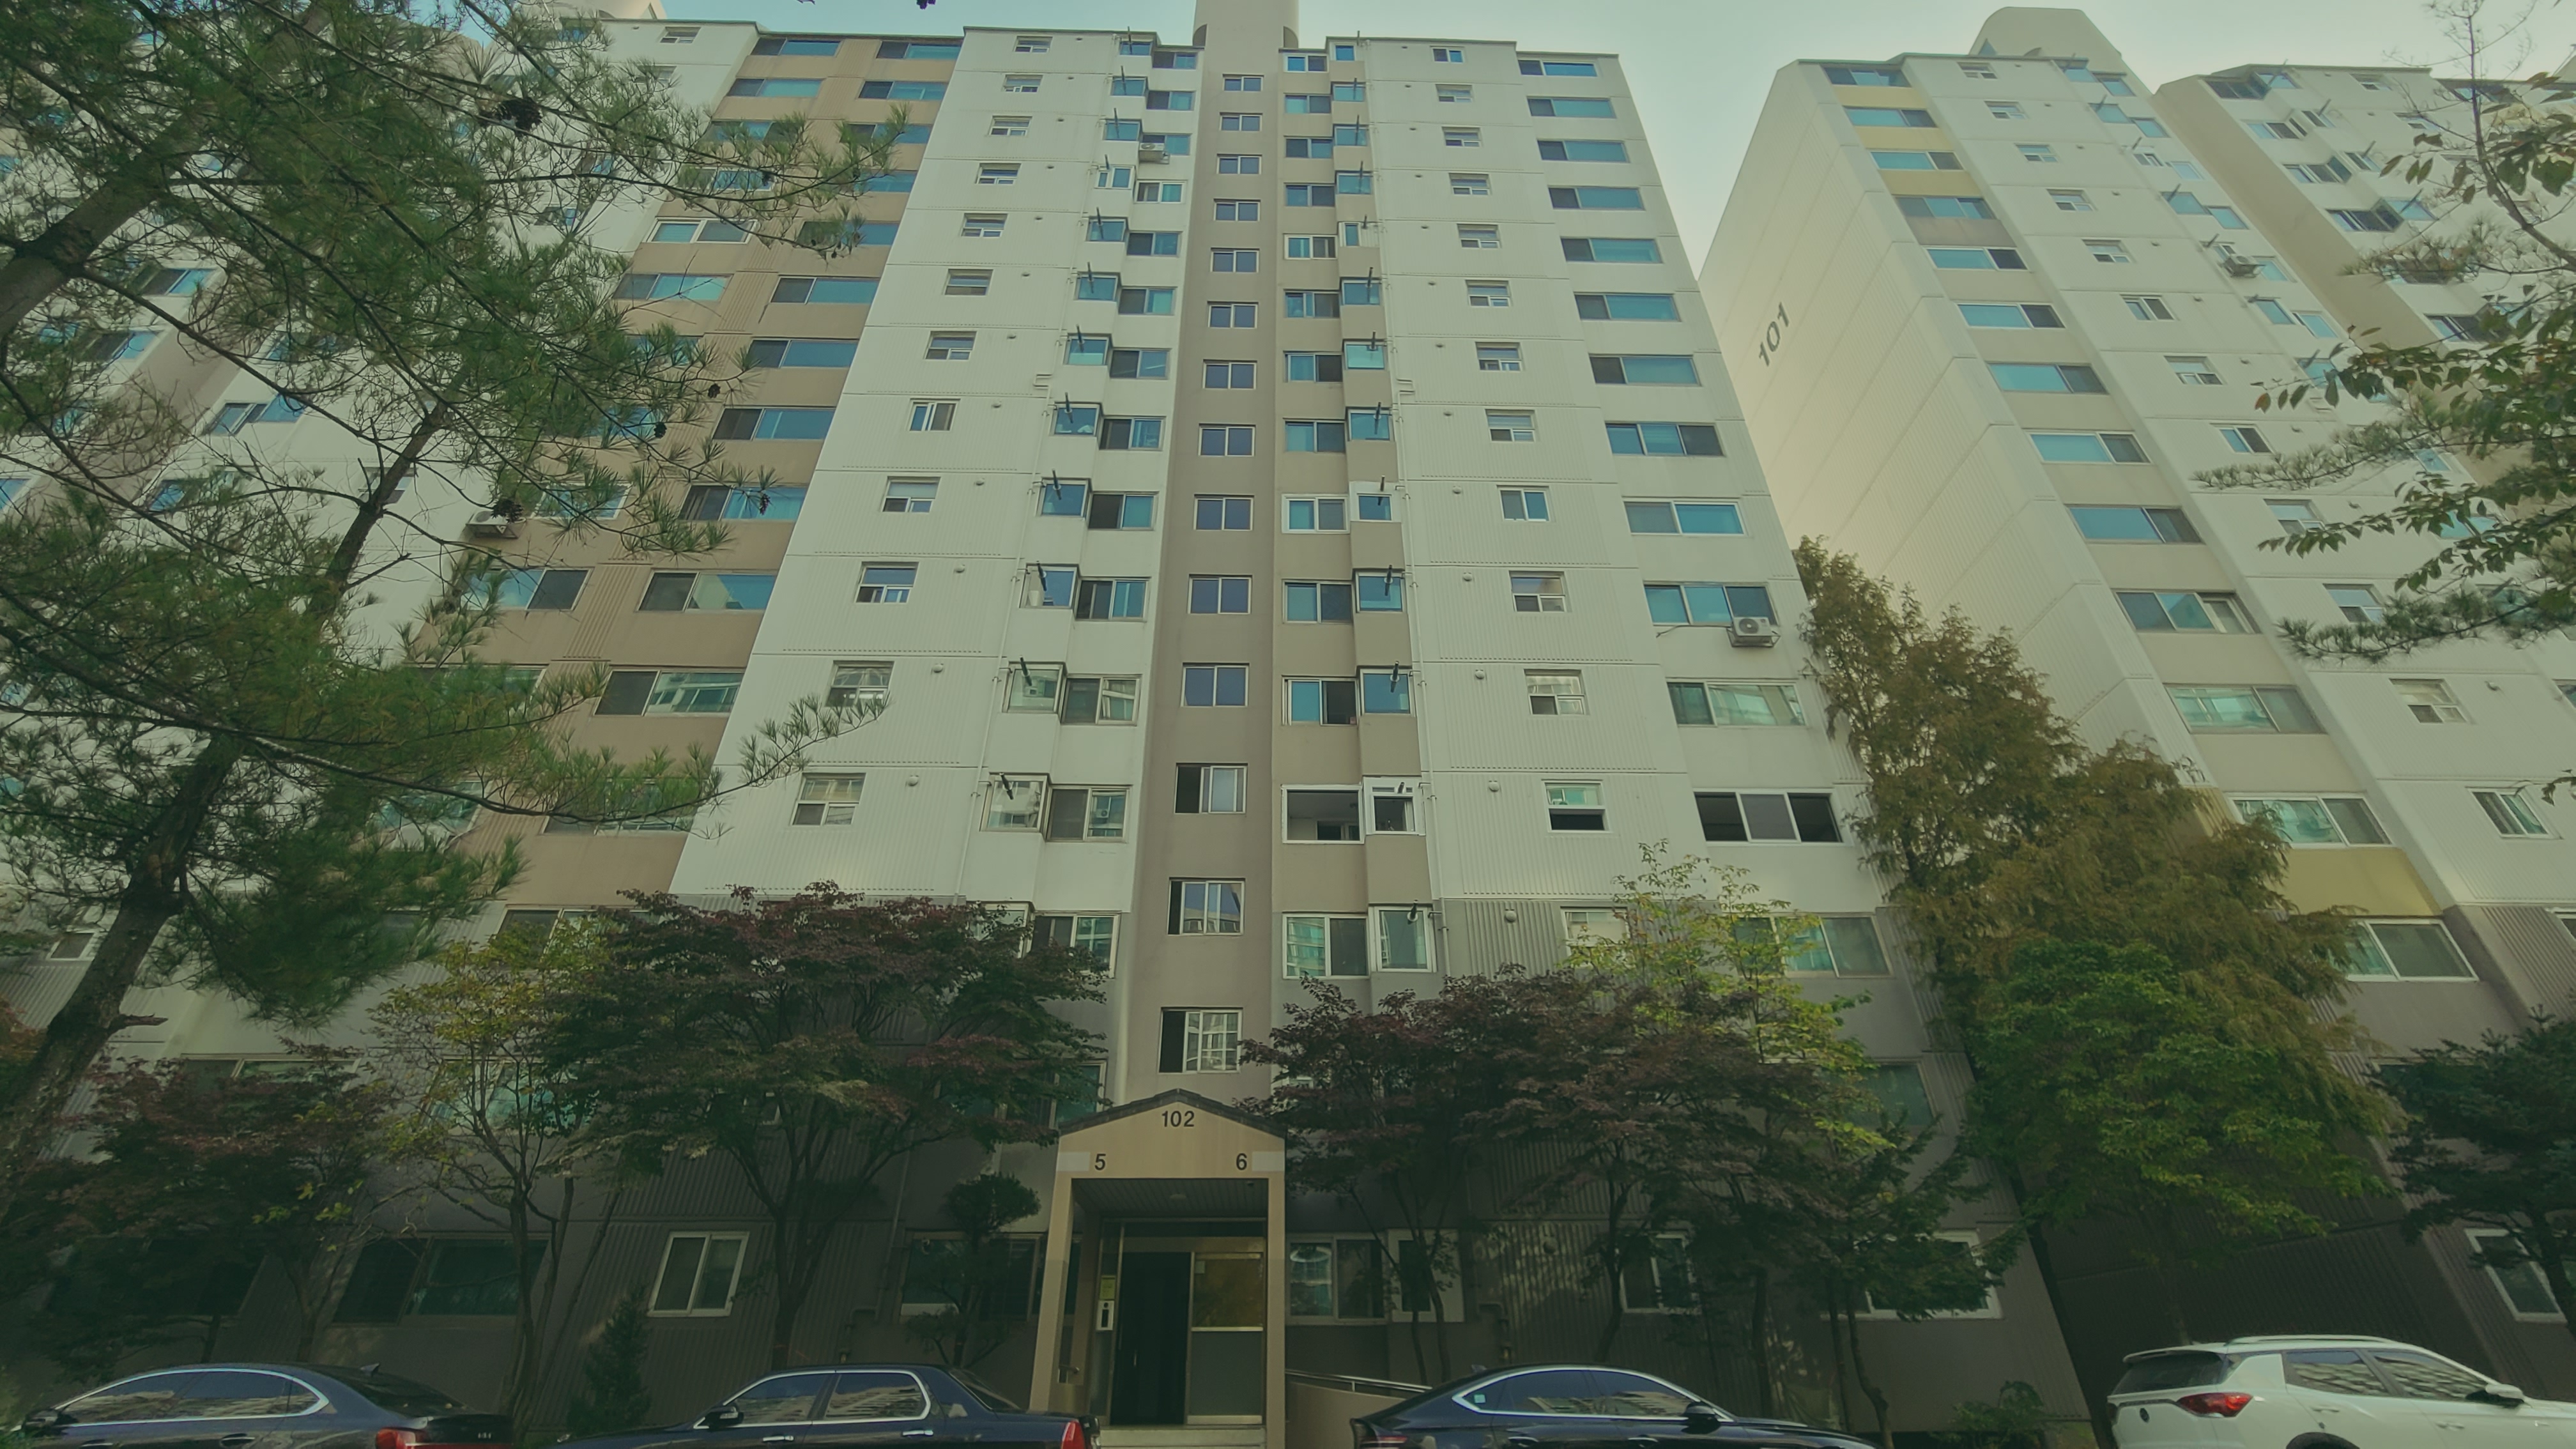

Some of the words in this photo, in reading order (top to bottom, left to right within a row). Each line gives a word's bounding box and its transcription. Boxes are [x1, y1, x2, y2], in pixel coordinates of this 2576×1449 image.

[1759, 302, 1789, 367] 101
[1162, 1110, 1194, 1127] 102
[1094, 1153, 1106, 1171] 5
[1236, 1153, 1248, 1170] 6
